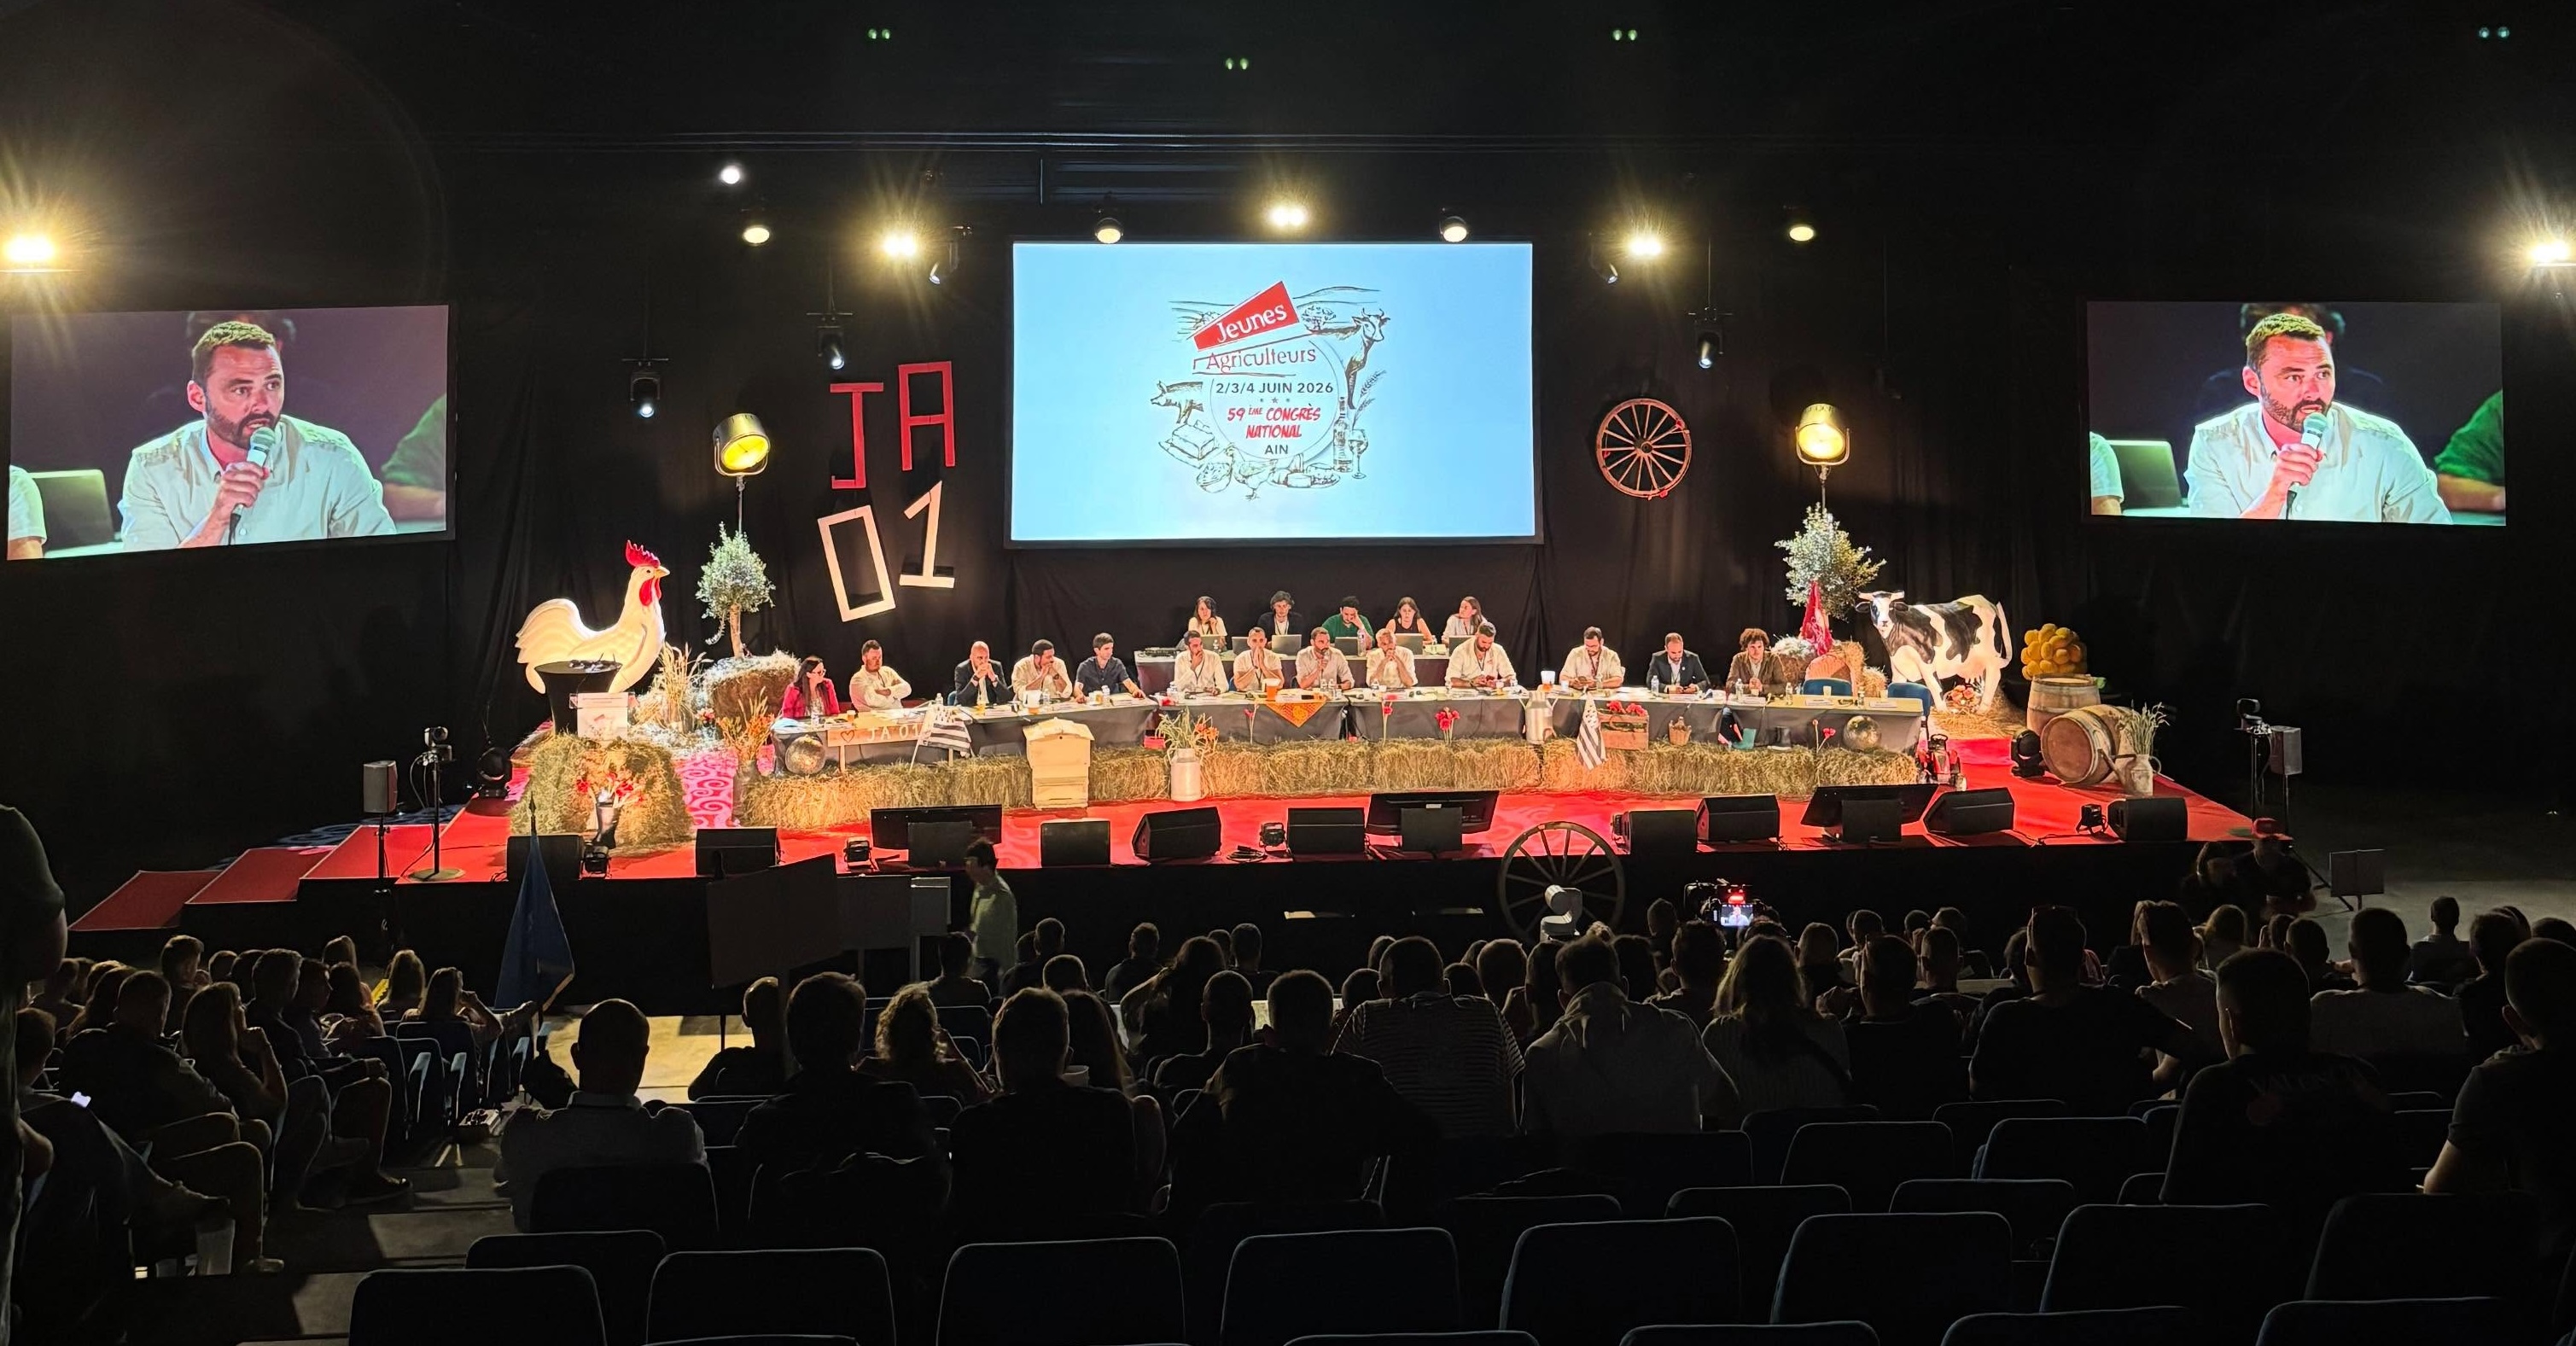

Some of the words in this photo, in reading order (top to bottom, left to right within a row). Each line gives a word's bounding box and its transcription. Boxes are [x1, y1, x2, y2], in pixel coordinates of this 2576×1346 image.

[1215, 303, 1287, 343] Jeunes
[1206, 347, 1316, 374] Agriculteurs
[1215, 382, 1255, 393] 2/3/4
[1258, 382, 1292, 393] JUIN
[1297, 382, 1334, 393] 2026
[1227, 407, 1246, 421] 59
[1266, 403, 1321, 421] CONGRÈS
[830, 360, 956, 490] JA
[1245, 424, 1303, 439] NATIONAL
[1264, 445, 1289, 455] AIN
[867, 725, 892, 742] JA
